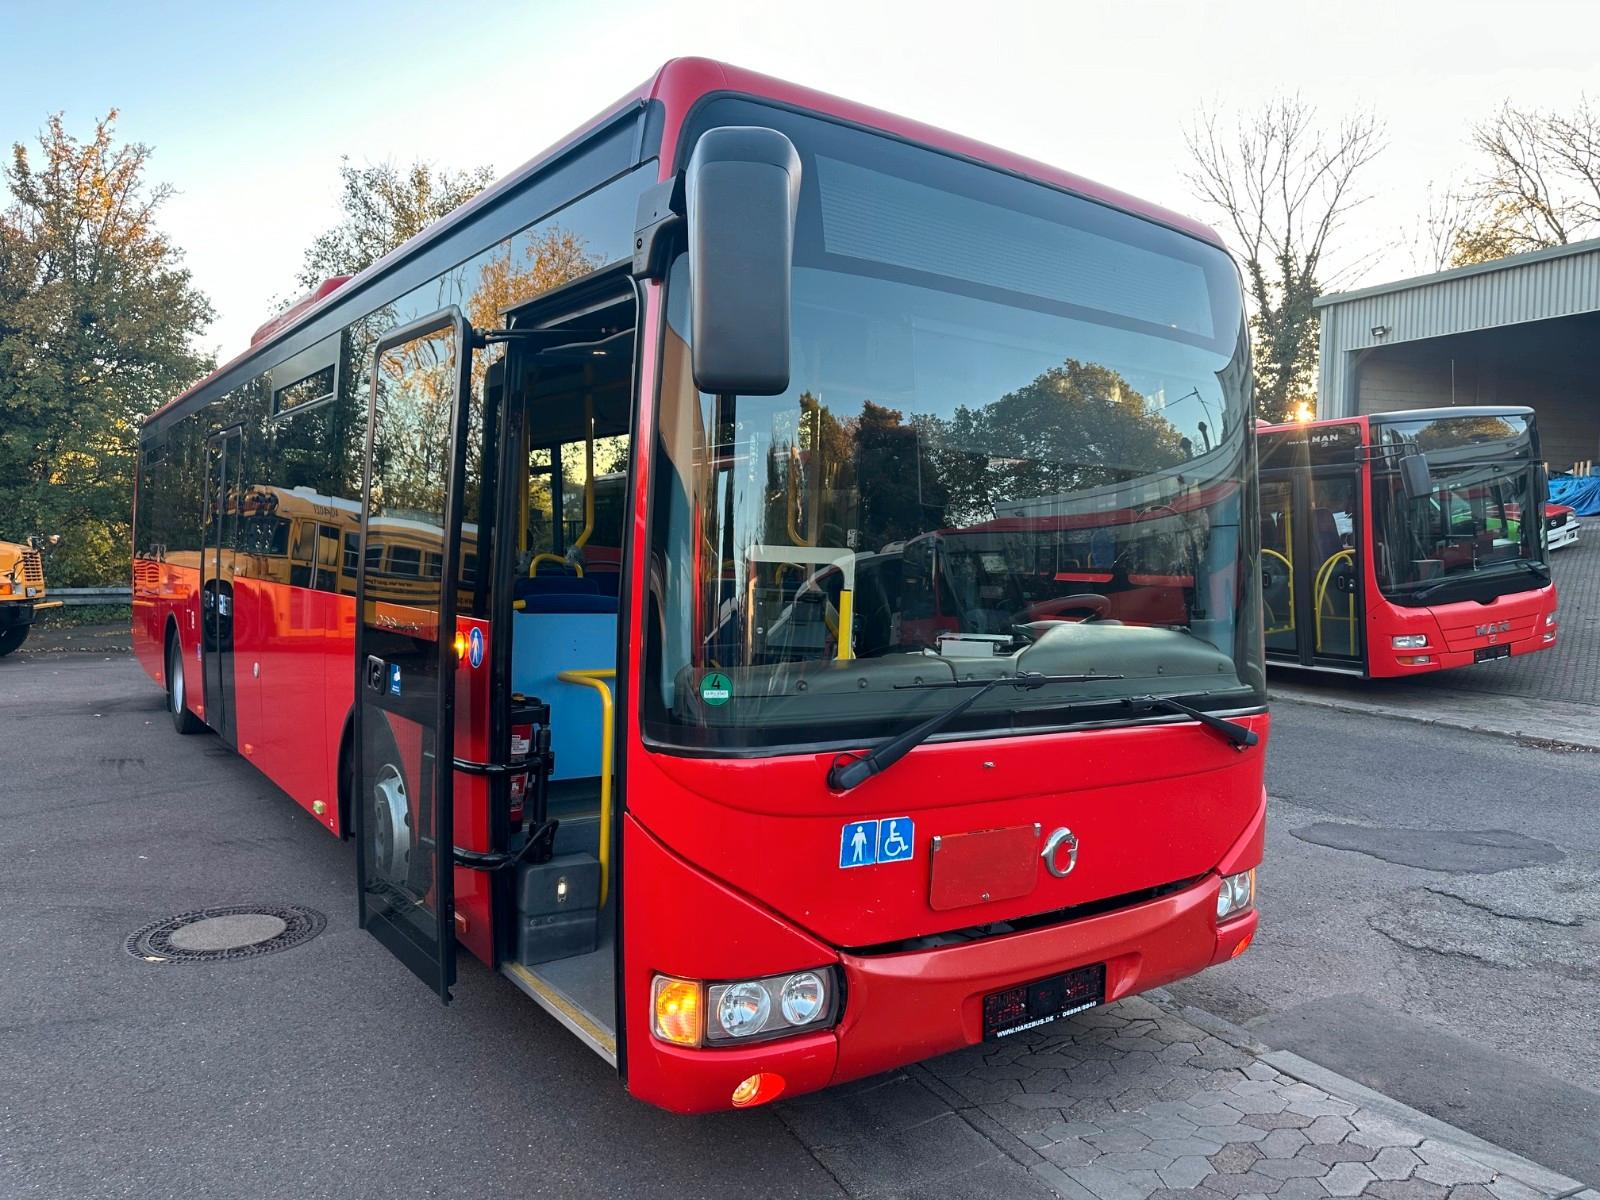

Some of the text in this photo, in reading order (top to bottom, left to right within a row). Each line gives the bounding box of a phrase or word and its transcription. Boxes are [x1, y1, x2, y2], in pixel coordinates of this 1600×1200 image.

[1312, 434, 1338, 443] MAN
[1475, 621, 1510, 636] MAN
[711, 674, 720, 689] 4
